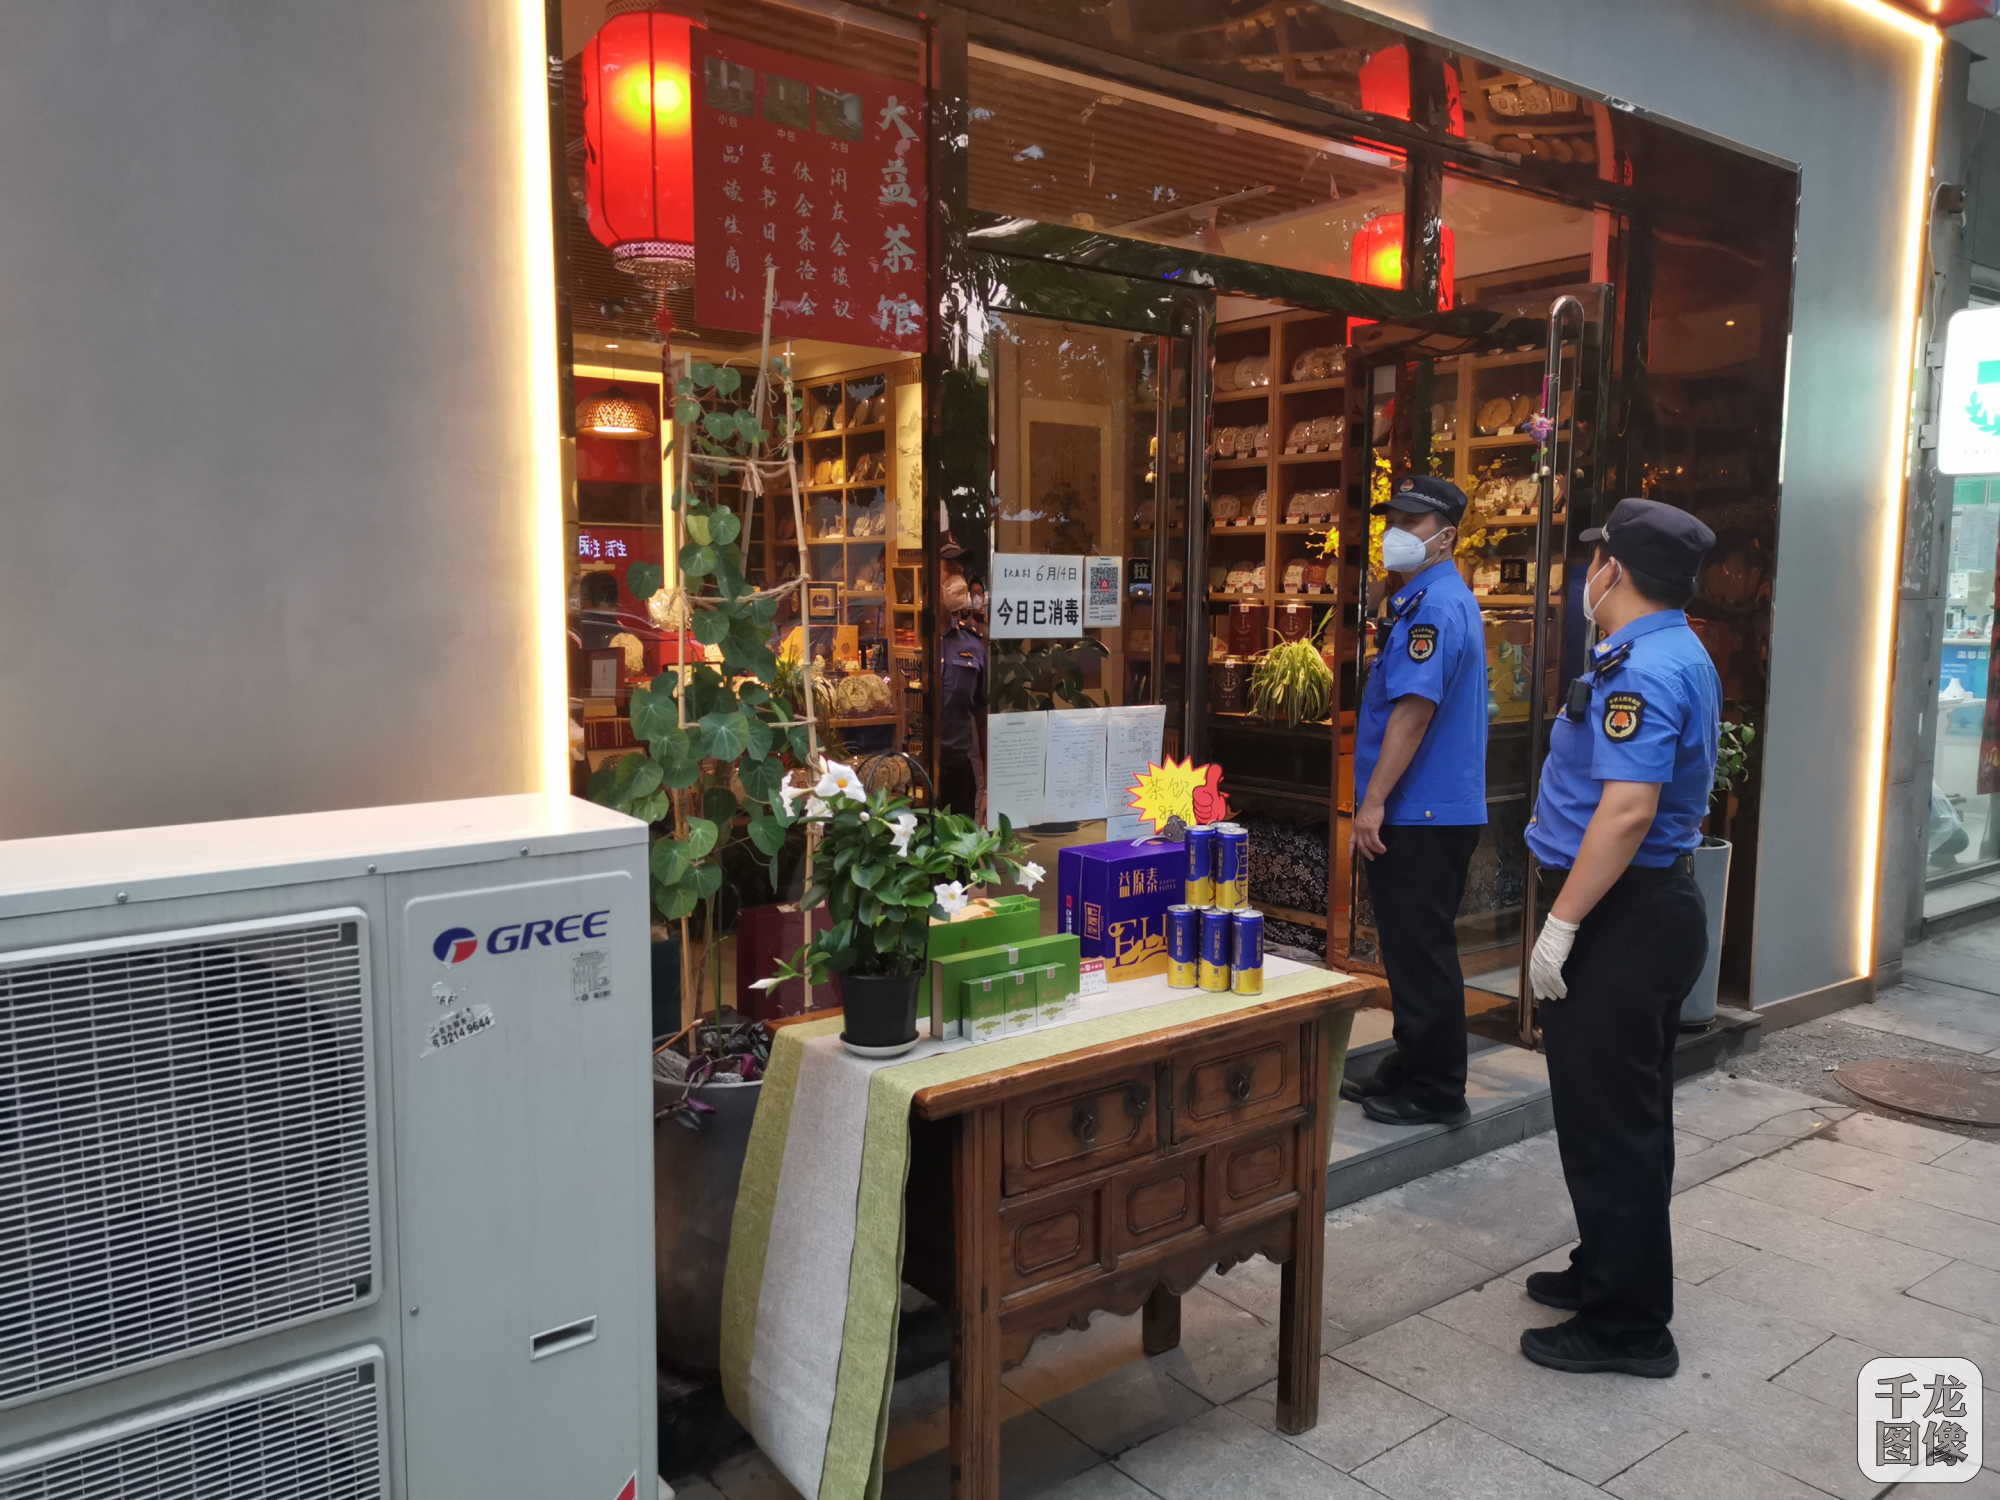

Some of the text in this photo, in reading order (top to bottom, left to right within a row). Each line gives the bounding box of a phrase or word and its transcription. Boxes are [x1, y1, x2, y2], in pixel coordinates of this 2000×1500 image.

[718, 114, 738, 128] 小包
[777, 128, 796, 142] 中包
[830, 141, 849, 154] 大包
[723, 145, 847, 192] 品茗休闲
[723, 178, 848, 223] 读书会友
[876, 95, 924, 336] 大益茶馆
[724, 213, 850, 257] 生日茶会
[1036, 565, 1078, 582] 6月14日
[1133, 562, 1149, 580] 拉
[996, 598, 1080, 627] 今日已消毒
[1145, 777, 1193, 800] 茶饮
[1118, 867, 1159, 899] 益原素
[486, 910, 611, 955] GREE
